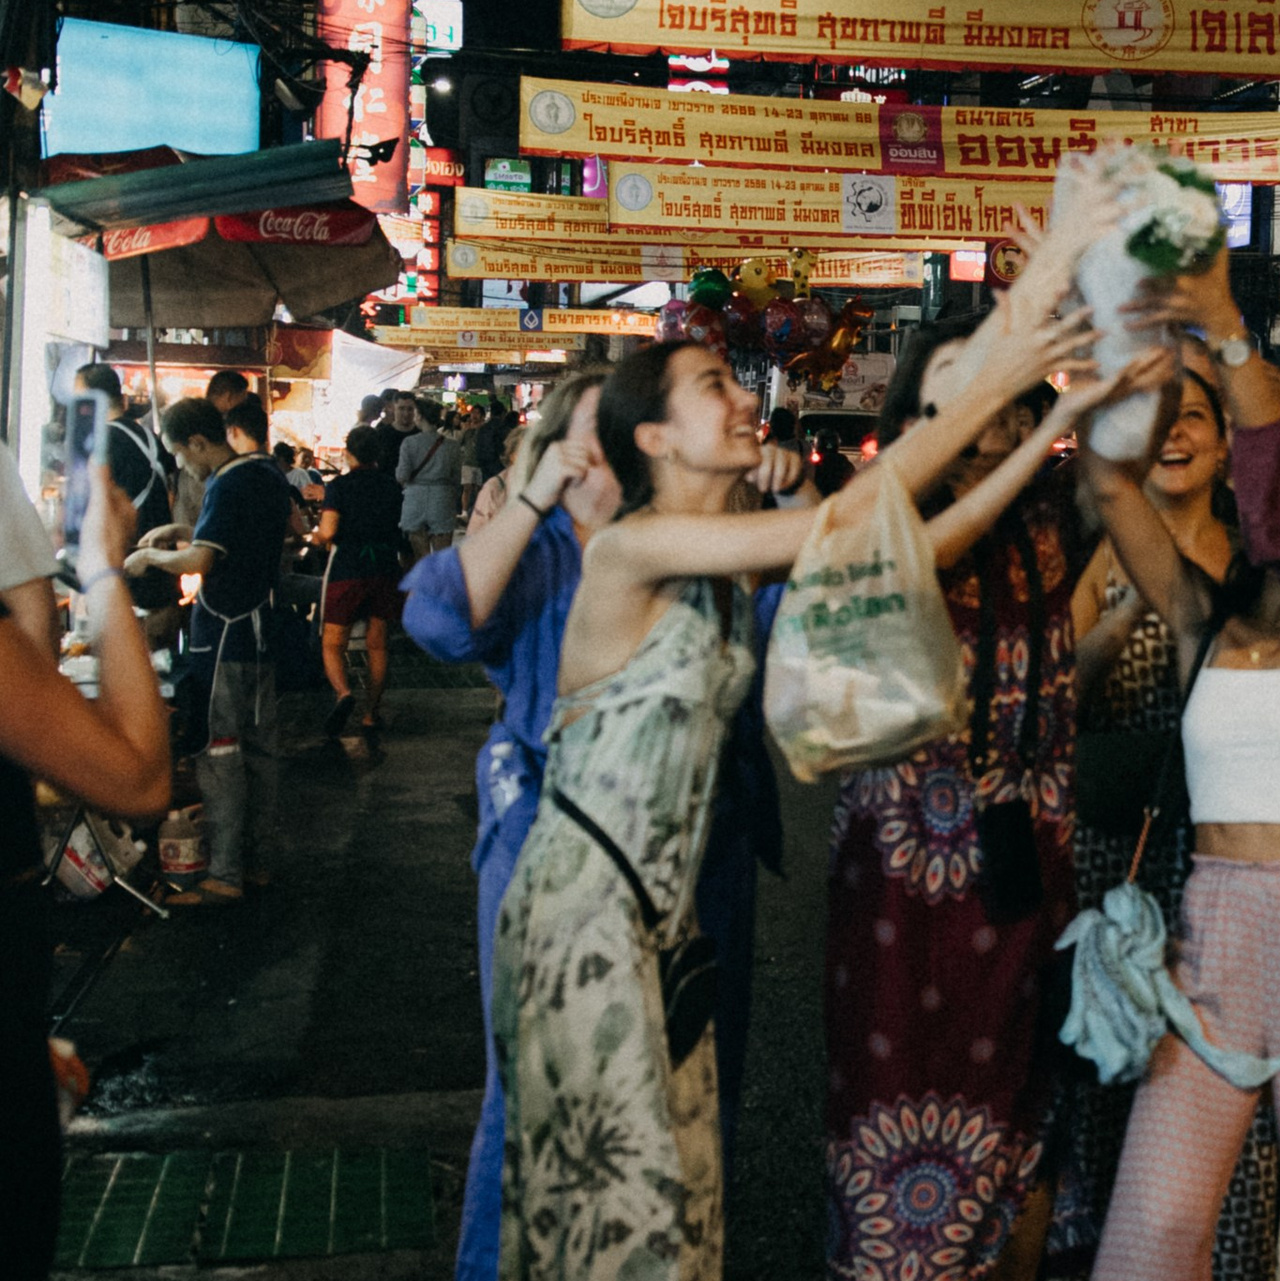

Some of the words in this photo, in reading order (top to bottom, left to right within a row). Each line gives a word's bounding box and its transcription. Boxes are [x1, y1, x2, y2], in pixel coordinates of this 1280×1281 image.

[817, 5, 946, 50] สุขภาพดี
[963, 7, 1071, 50] มีมงคล
[721, 103, 756, 117] 2566
[763, 107, 803, 121] 14-23
[855, 112, 872, 124] 66
[955, 109, 1035, 128] ธนาคาร
[1150, 115, 1199, 133] สาขา
[582, 113, 686, 154] ใจบริสุทธิ์
[699, 129, 789, 157] สุขภาพดี
[799, 131, 875, 158] มีมงคล
[657, 191, 723, 224] ใจบริสุทธิ์
[729, 198, 786, 226] สุขภาพดี
[792, 198, 841, 224] มีมงคล
[258, 210, 331, 242] Coca-Cola
